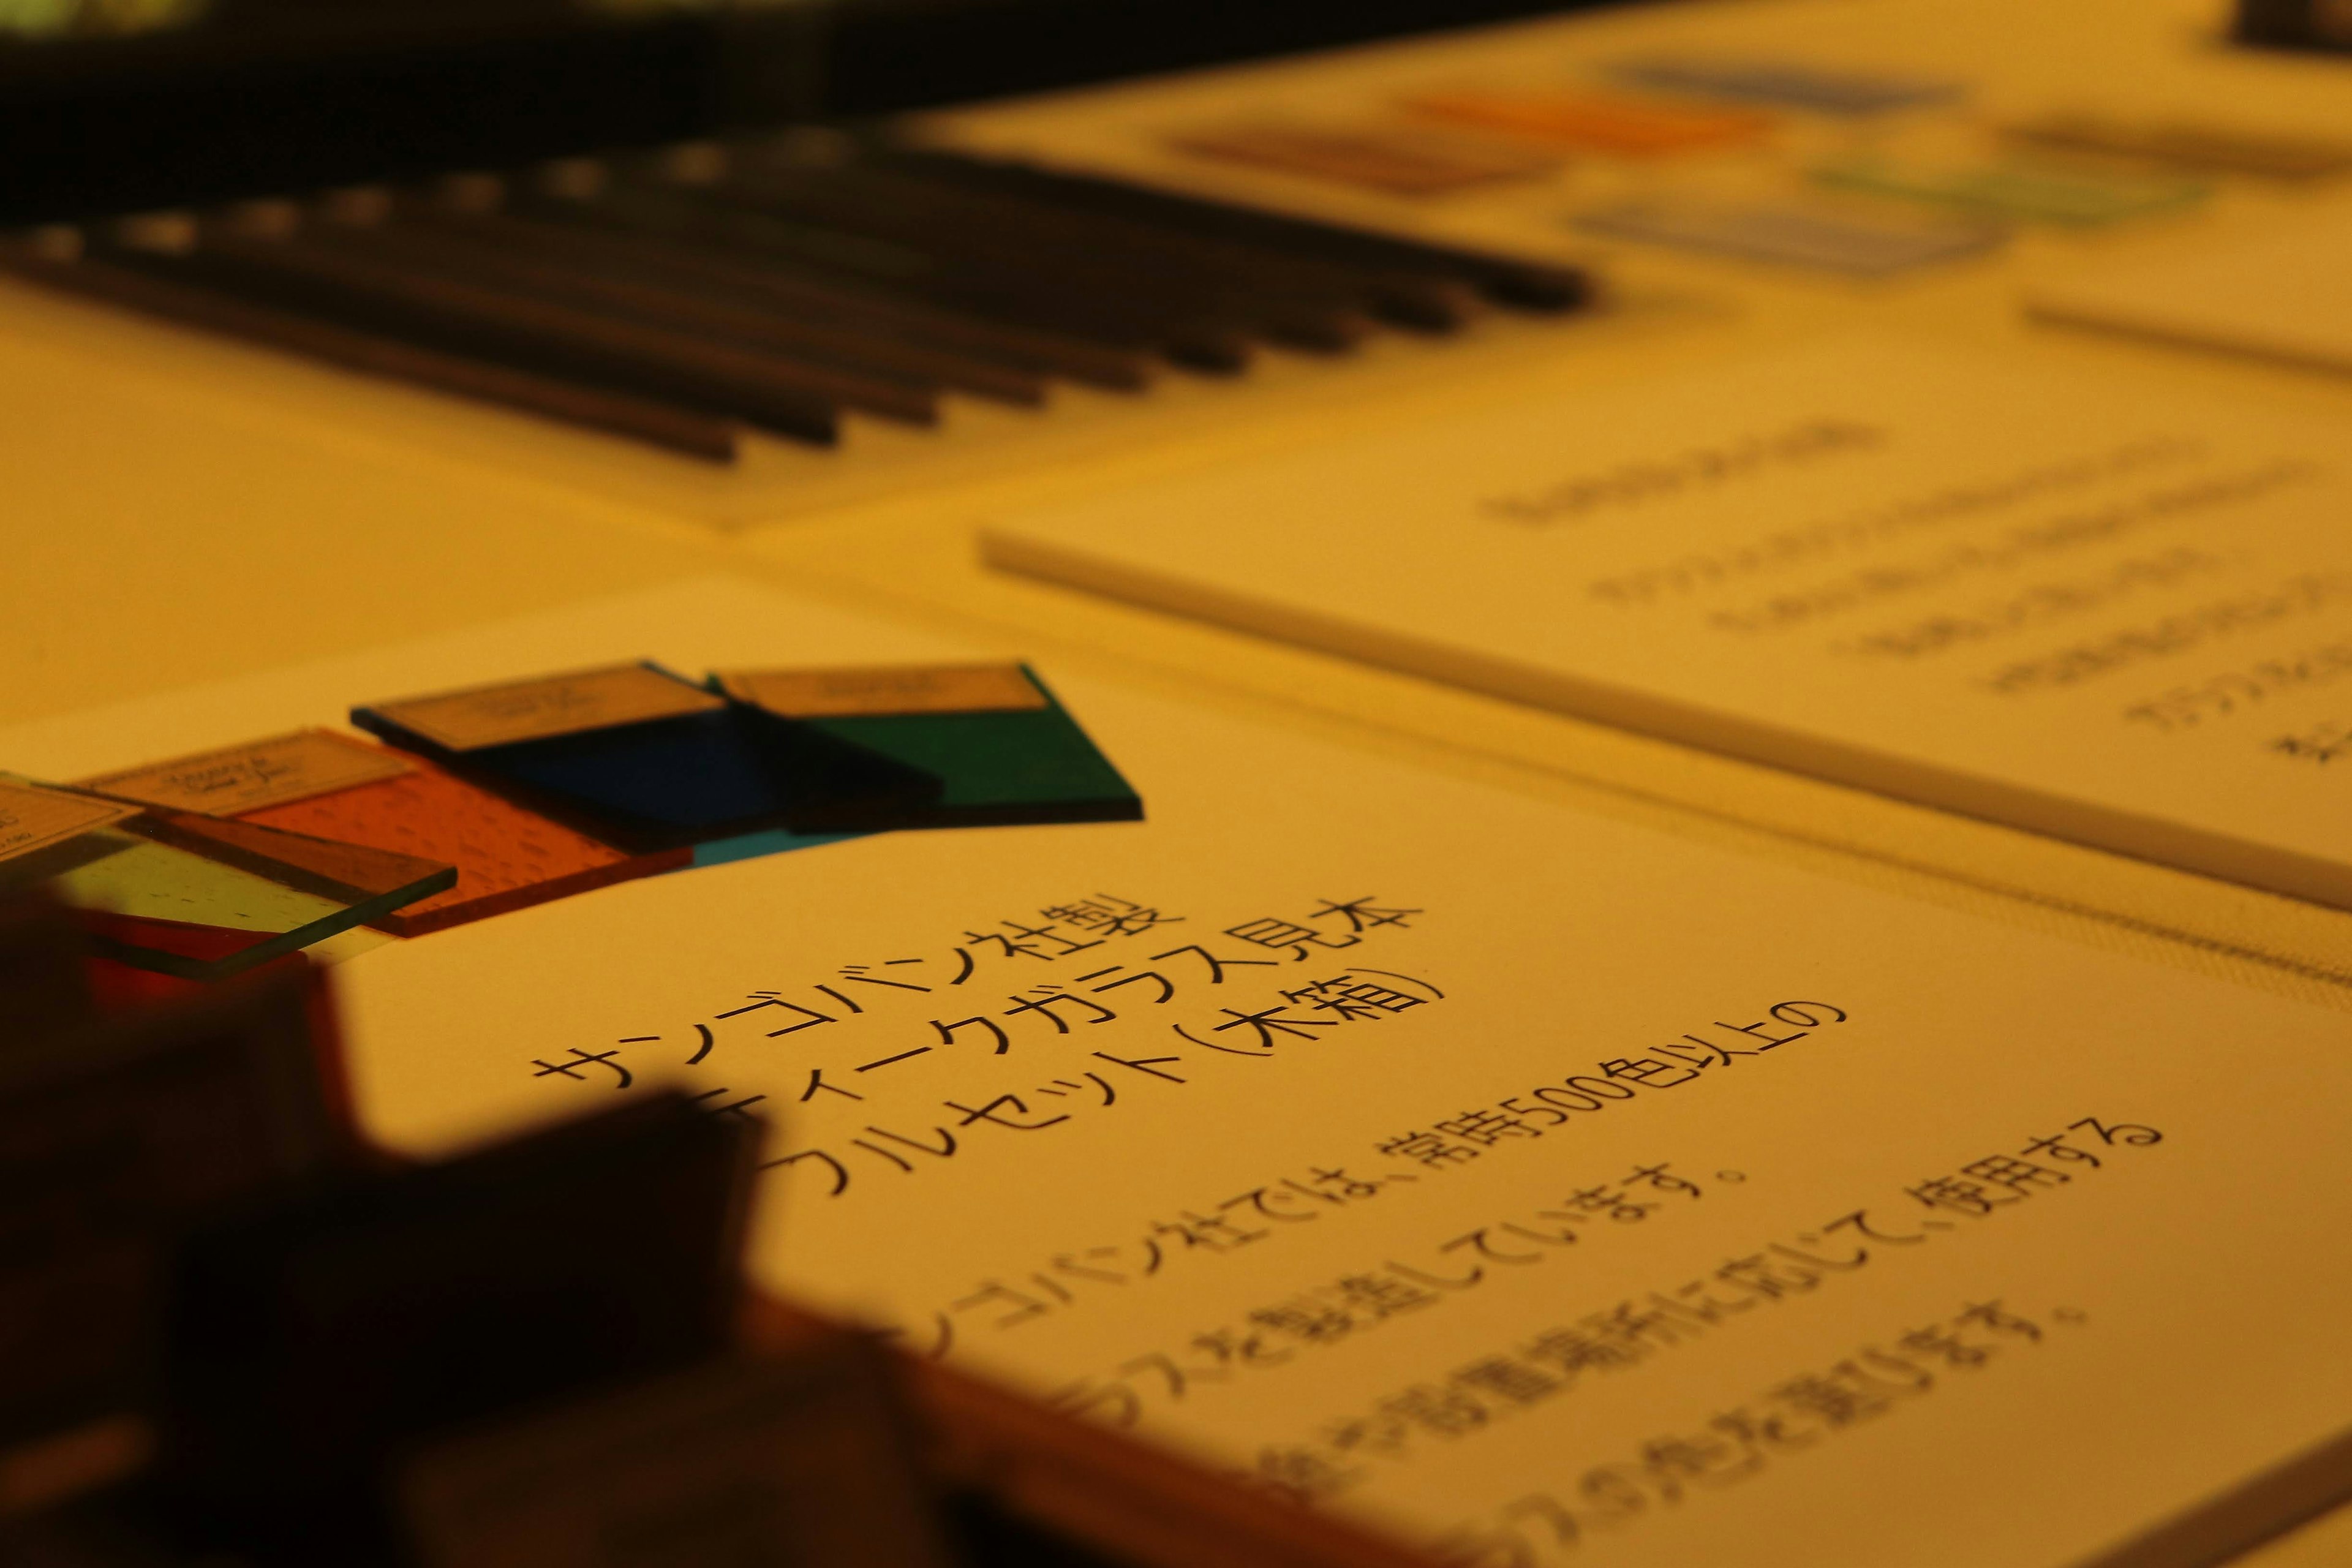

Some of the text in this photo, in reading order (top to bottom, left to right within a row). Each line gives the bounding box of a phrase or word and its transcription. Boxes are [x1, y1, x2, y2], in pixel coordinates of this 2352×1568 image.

[531, 893, 1186, 1089] サンゴバン社製
